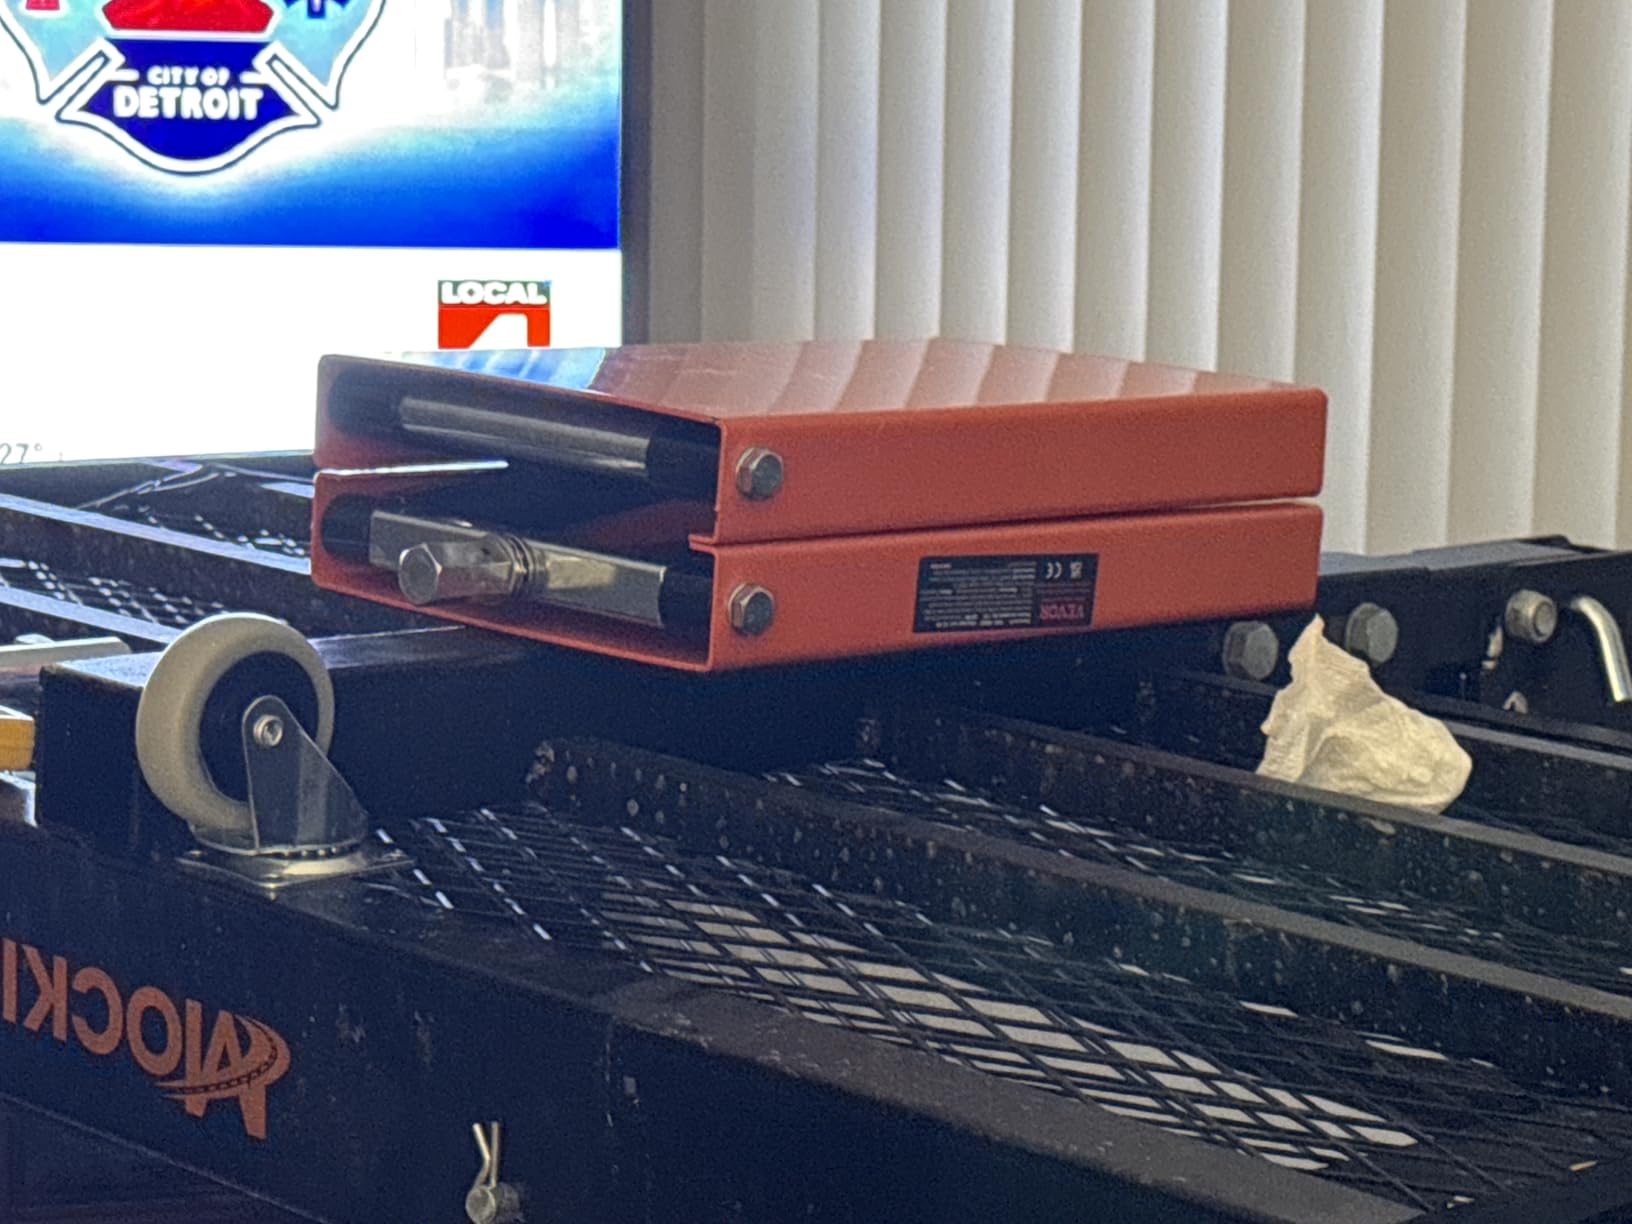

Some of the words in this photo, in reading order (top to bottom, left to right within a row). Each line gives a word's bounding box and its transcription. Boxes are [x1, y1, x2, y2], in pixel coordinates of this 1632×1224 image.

[147, 66, 199, 86] CITY
[200, 66, 231, 86] OF
[112, 86, 264, 120] DETROIT
[440, 280, 548, 305] LOCAL
